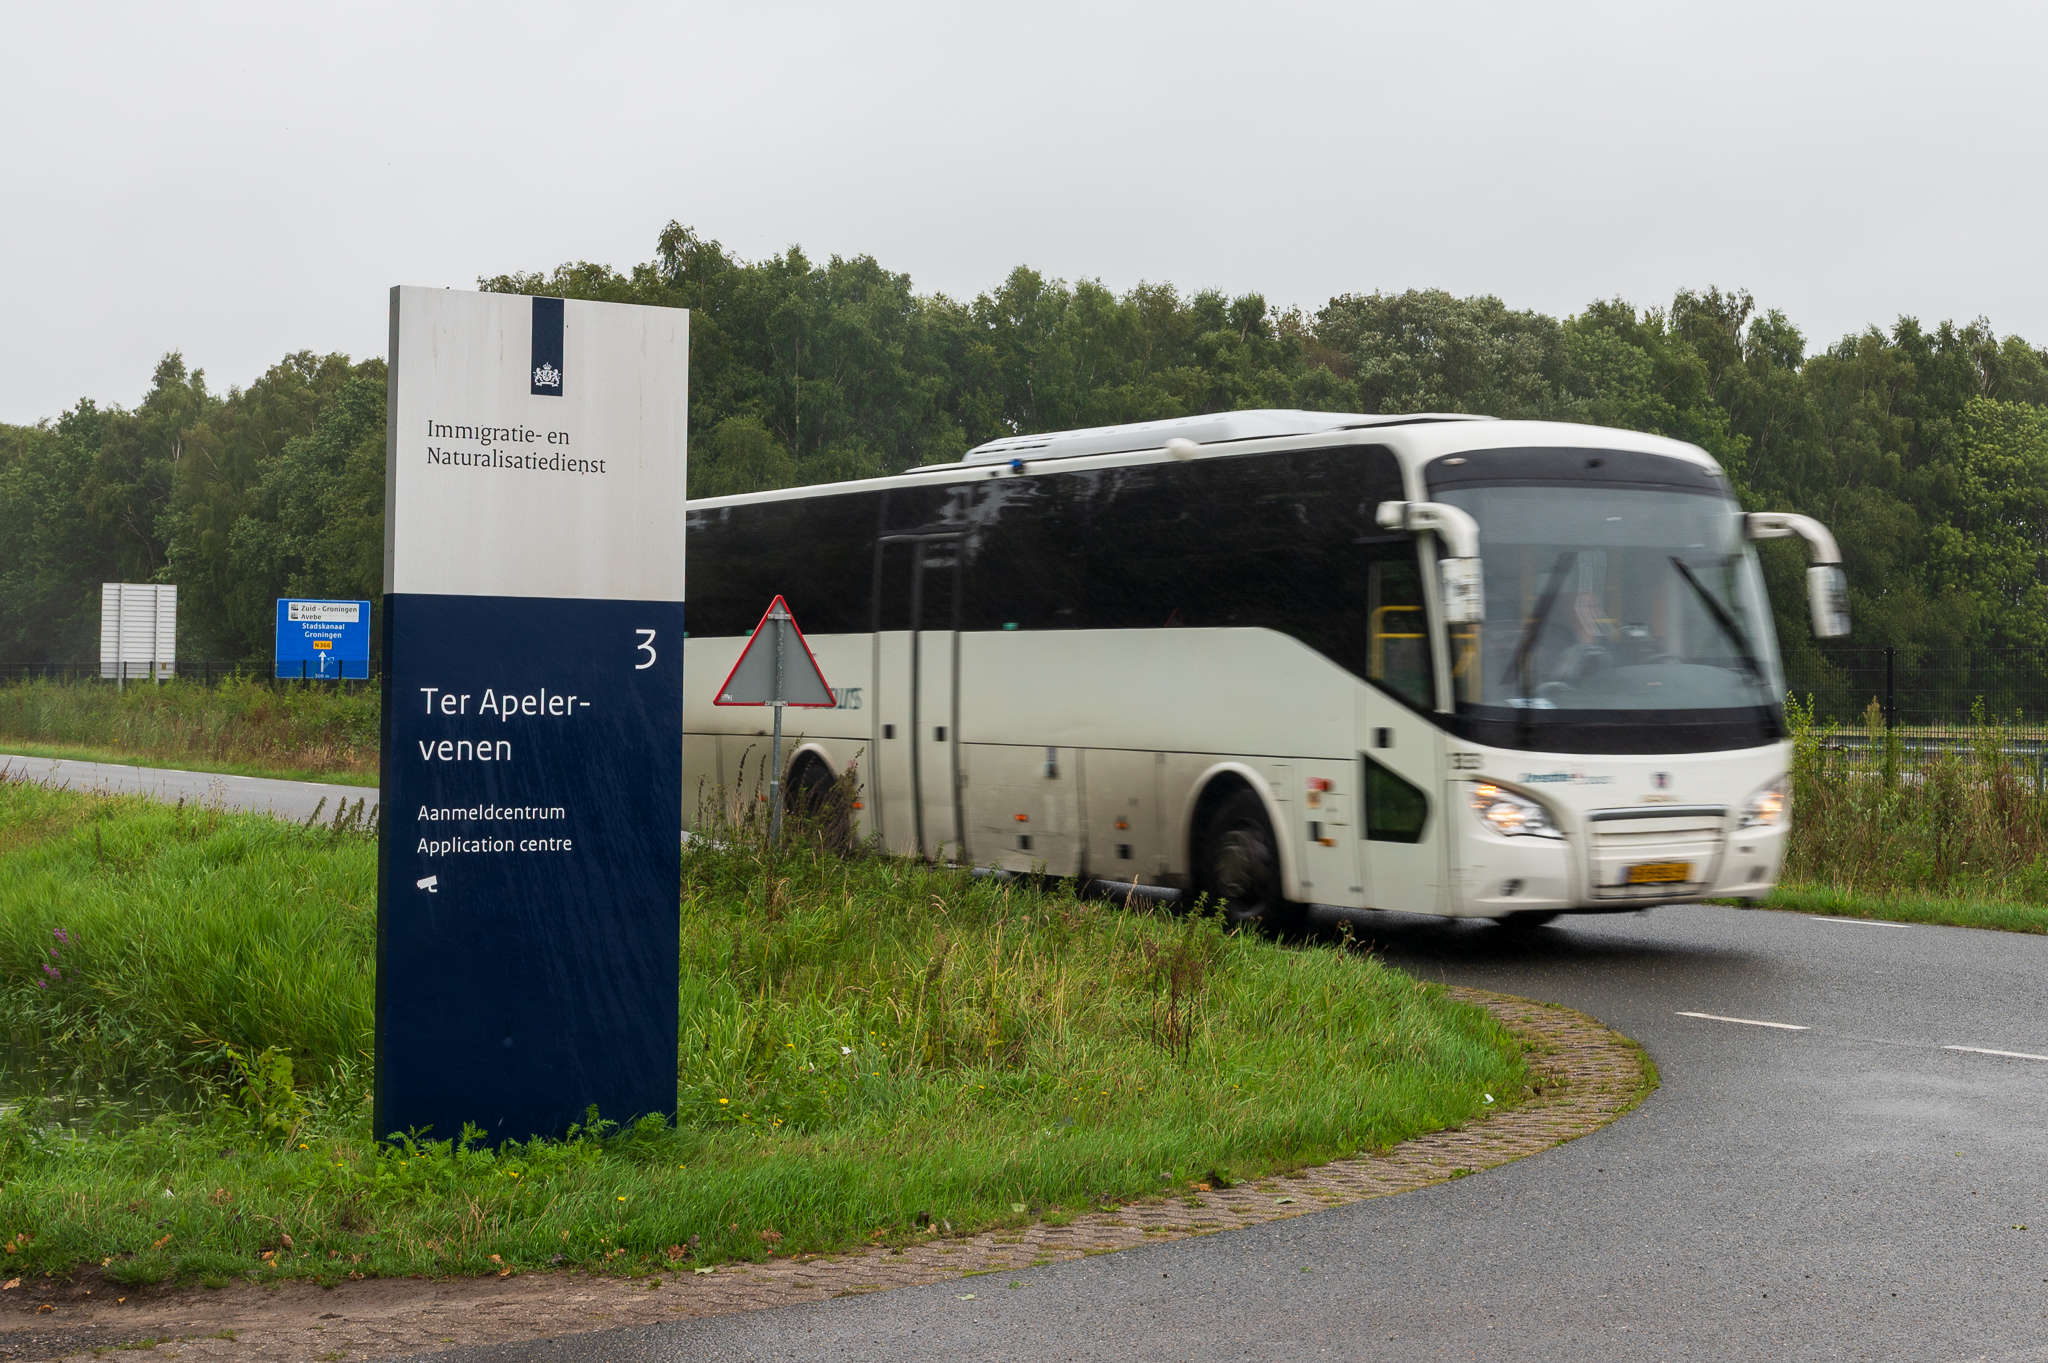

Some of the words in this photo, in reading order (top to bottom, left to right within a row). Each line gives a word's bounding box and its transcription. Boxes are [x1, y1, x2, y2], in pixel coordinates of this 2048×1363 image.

[427, 419, 542, 446] Immigratie-
[547, 430, 570, 445] en
[427, 447, 606, 474] Naturalisatiedienst
[322, 605, 358, 614] Groningen
[302, 622, 345, 630] Stadskanaal
[304, 631, 342, 639] Groningen
[635, 628, 657, 669] 3
[420, 687, 471, 715] Ter
[478, 687, 590, 723] Apeler-
[418, 739, 512, 761] venen
[417, 804, 565, 821] Aanmeldcentrum
[417, 836, 515, 857] Application
[519, 837, 572, 852] centre
